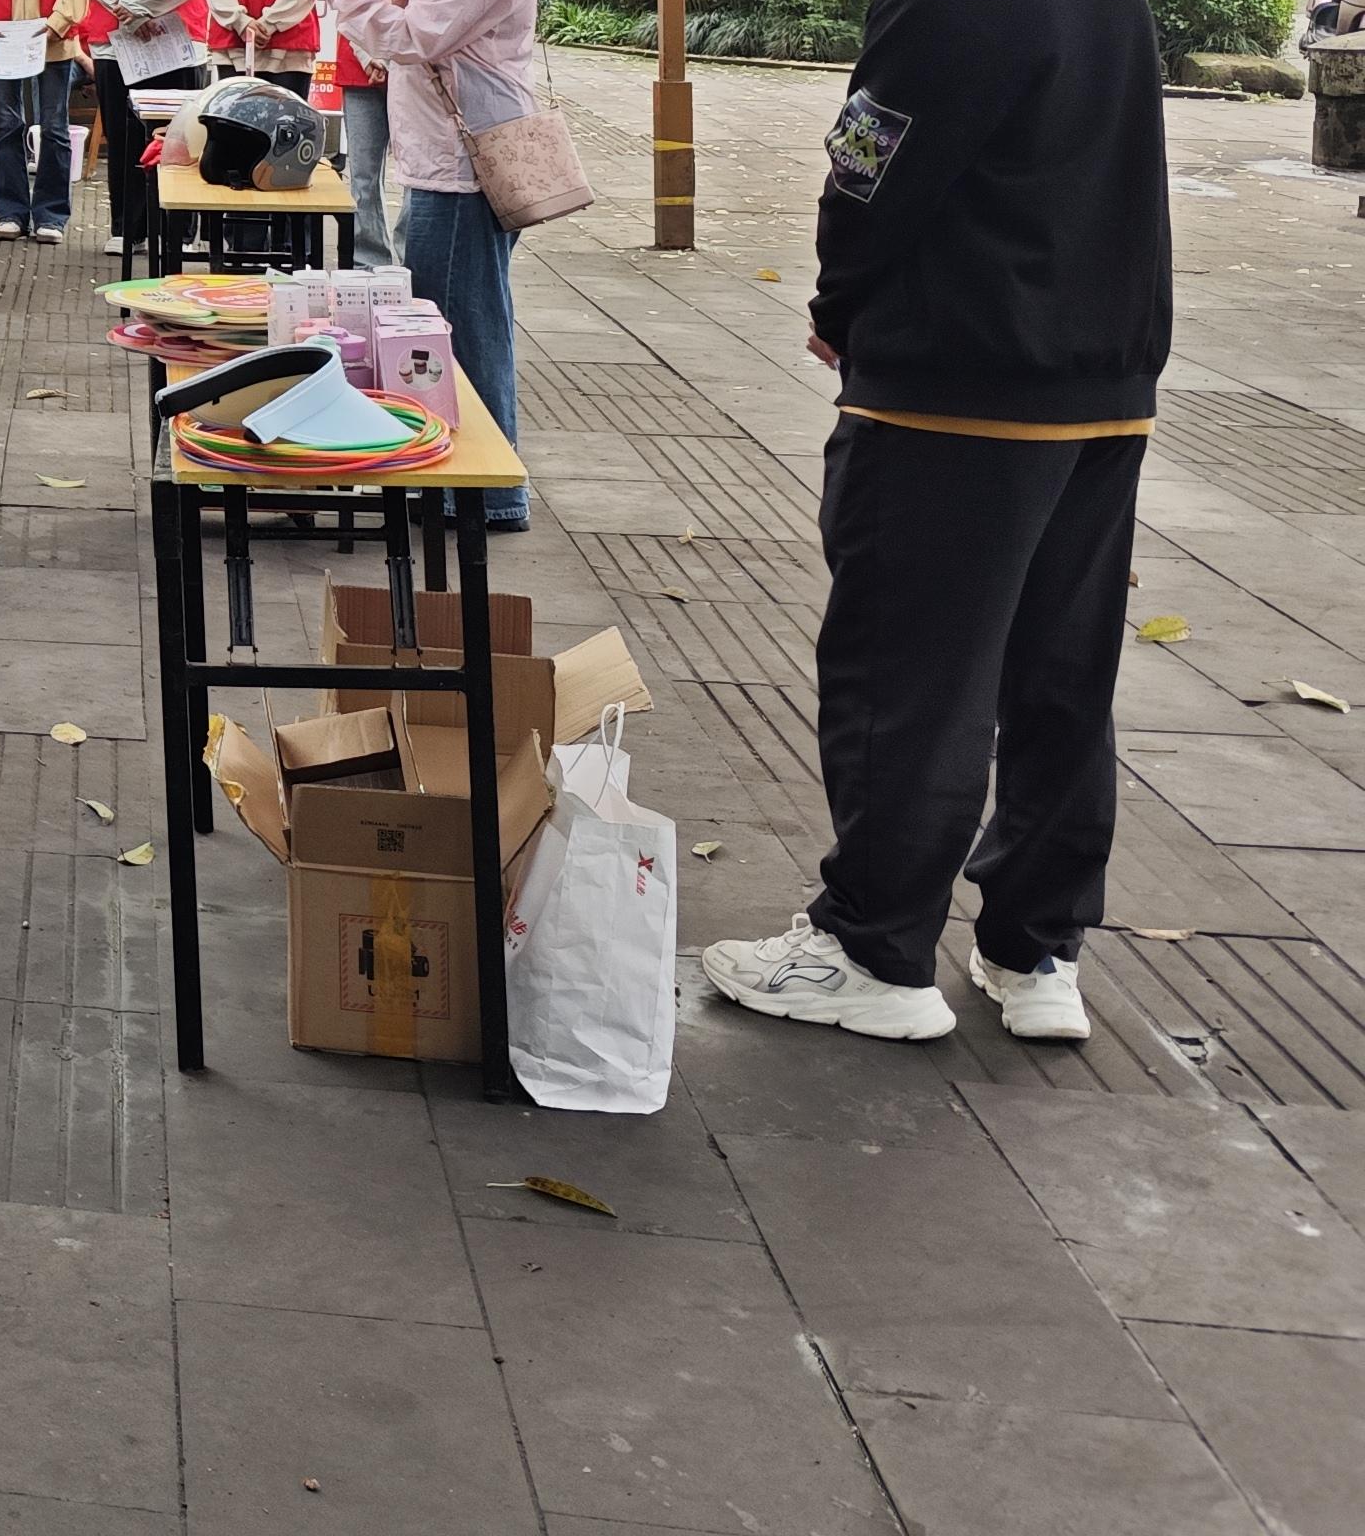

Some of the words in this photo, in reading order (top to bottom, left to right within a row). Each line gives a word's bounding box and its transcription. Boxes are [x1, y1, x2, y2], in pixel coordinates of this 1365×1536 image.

[845, 116, 889, 147] CROSS
[857, 111, 881, 129] NO
[829, 145, 877, 179] CROWN
[841, 142, 865, 161] NO
